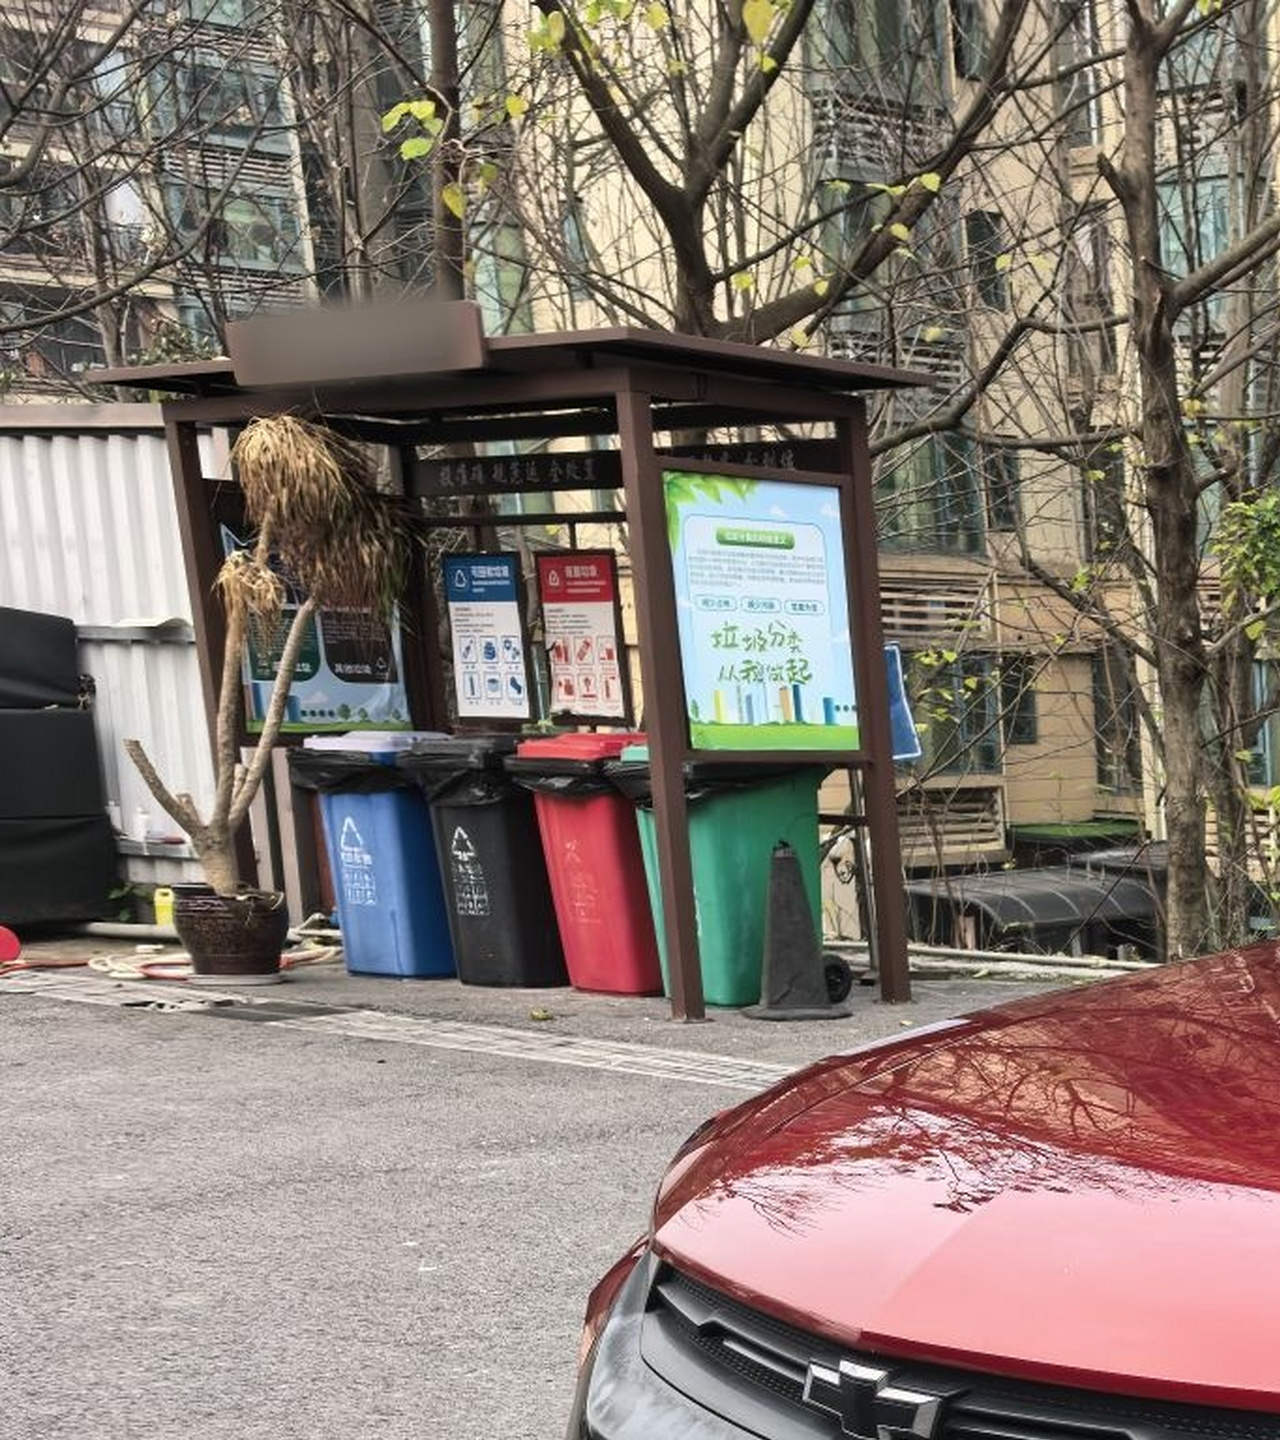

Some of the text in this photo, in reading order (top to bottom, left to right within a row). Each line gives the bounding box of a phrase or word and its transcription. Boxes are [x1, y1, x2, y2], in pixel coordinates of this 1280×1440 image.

[711, 619, 803, 653] 垃圾分类
[717, 658, 813, 685] 从我做起
